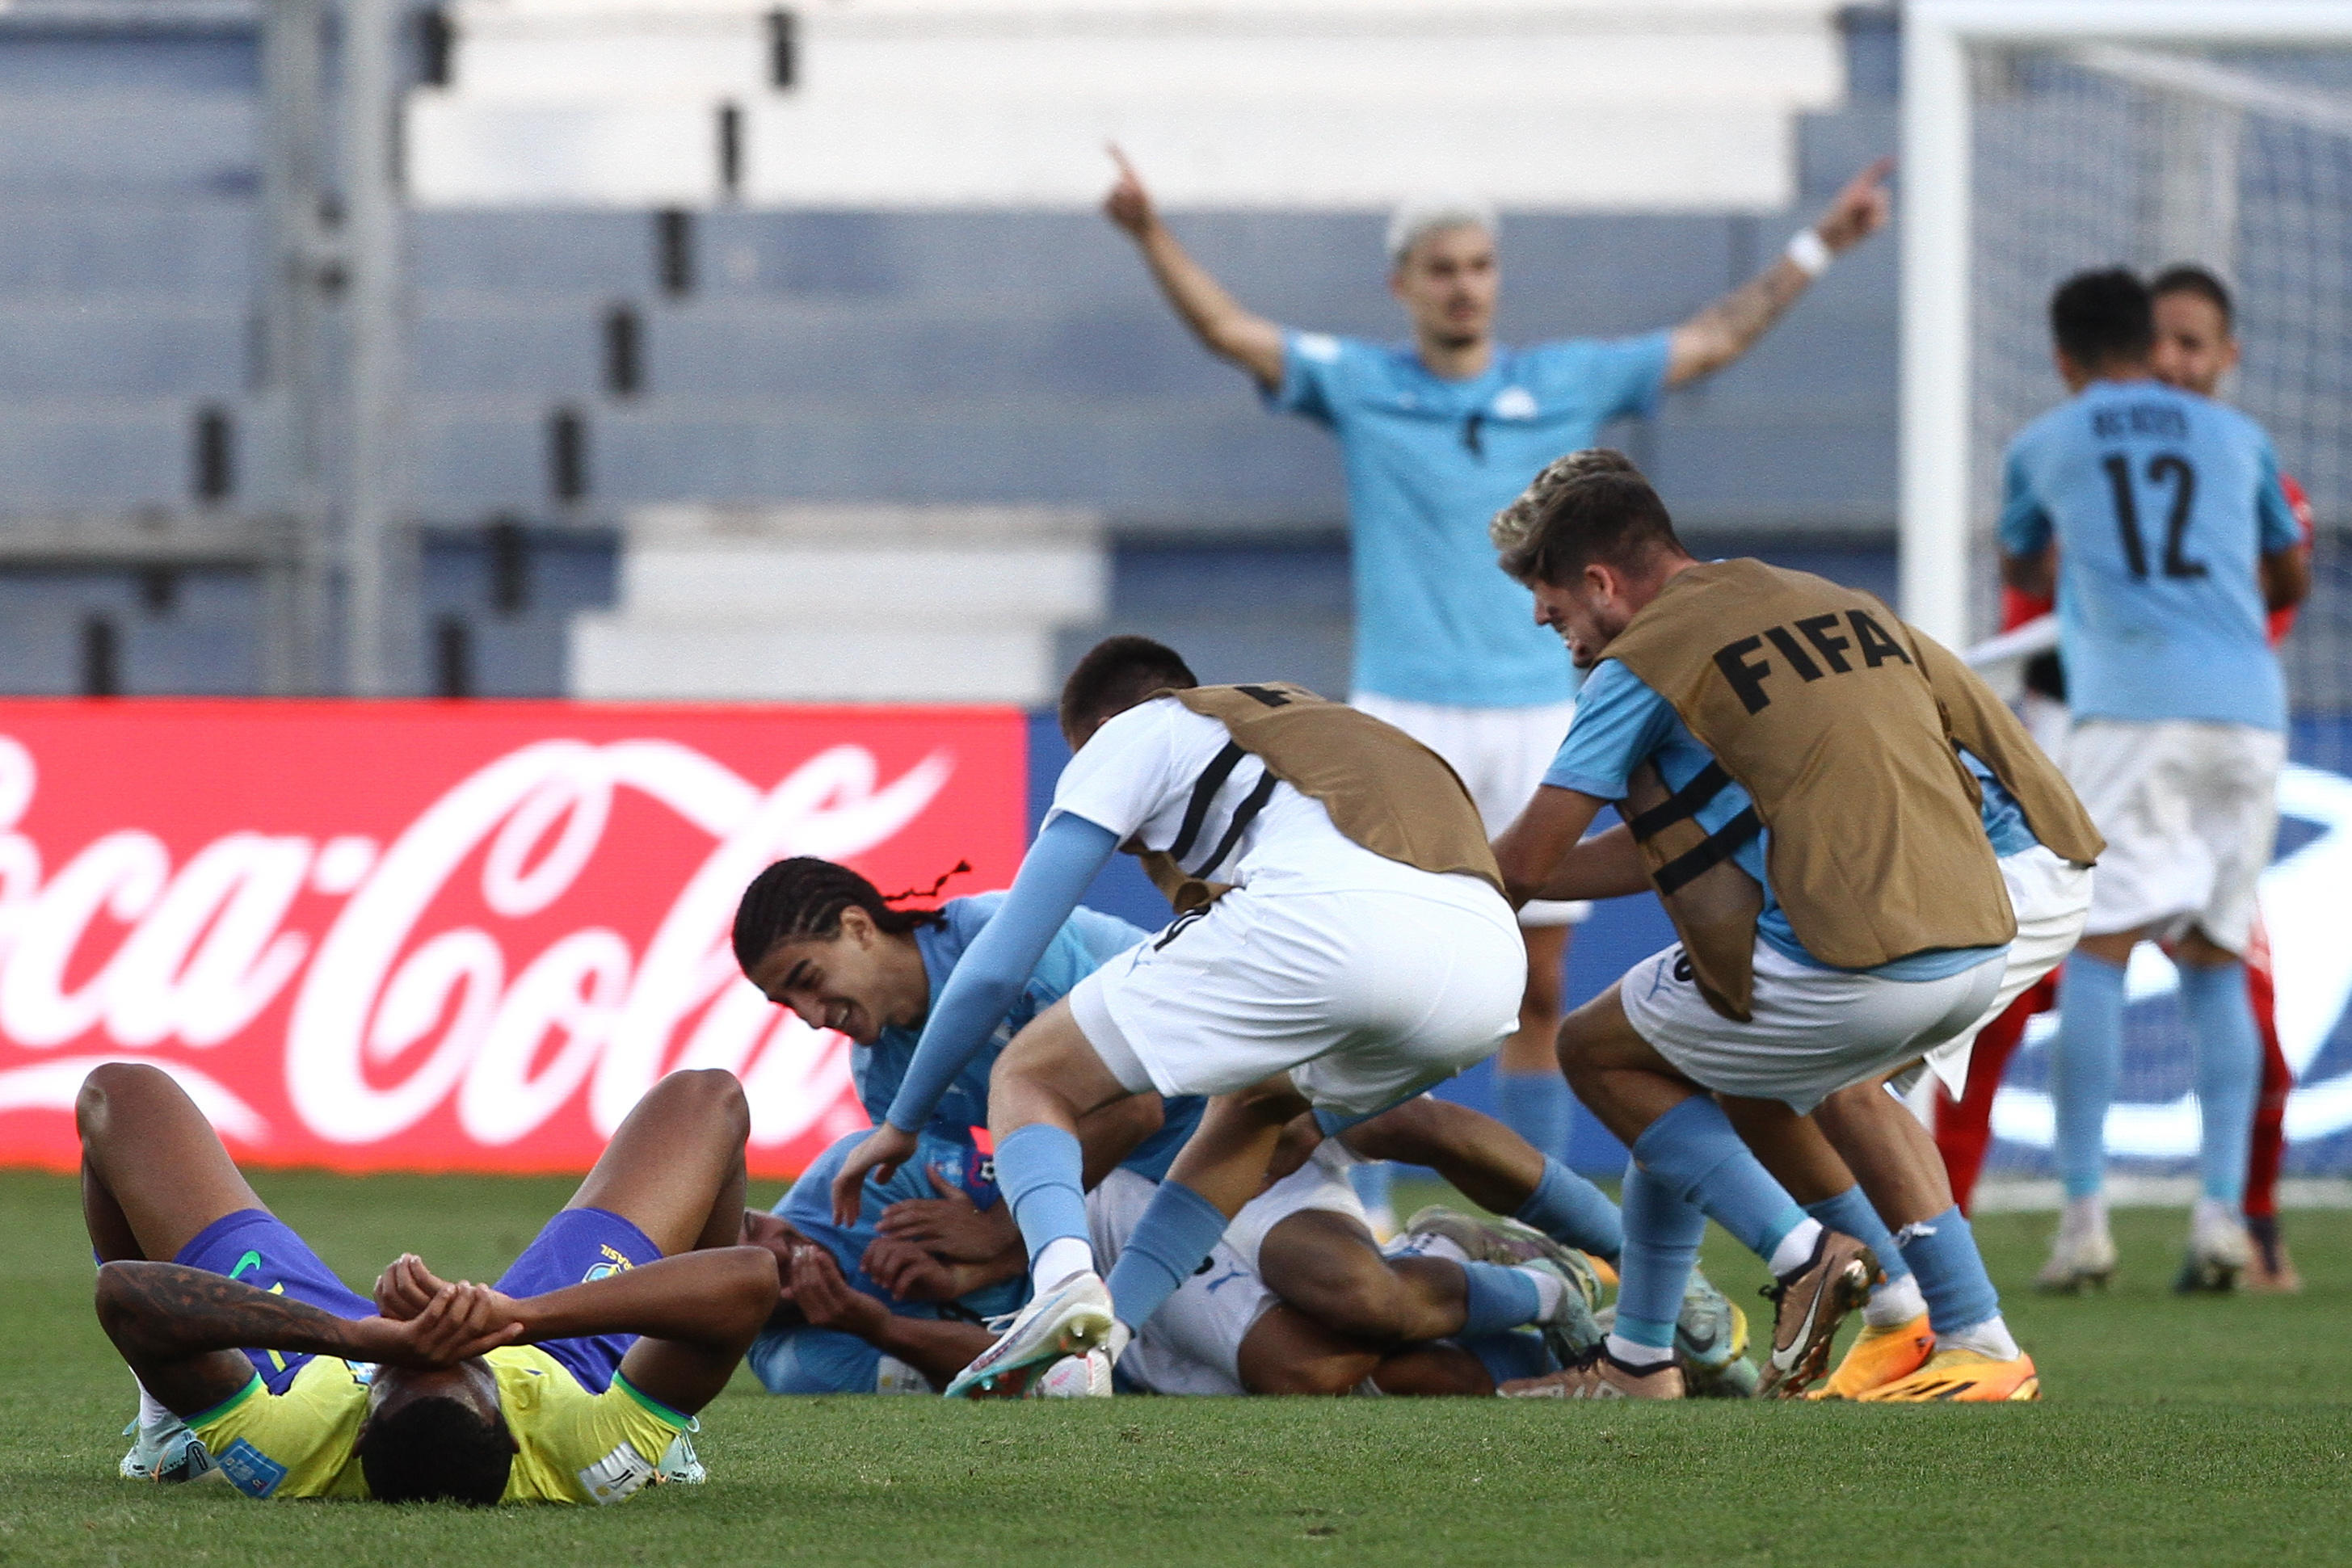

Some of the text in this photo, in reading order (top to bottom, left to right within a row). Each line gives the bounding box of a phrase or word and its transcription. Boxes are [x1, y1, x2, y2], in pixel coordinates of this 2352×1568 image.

[2102, 452, 2209, 581] 12
[1712, 609, 1913, 716] FIFA
[600, 1243, 634, 1271] RASIL
